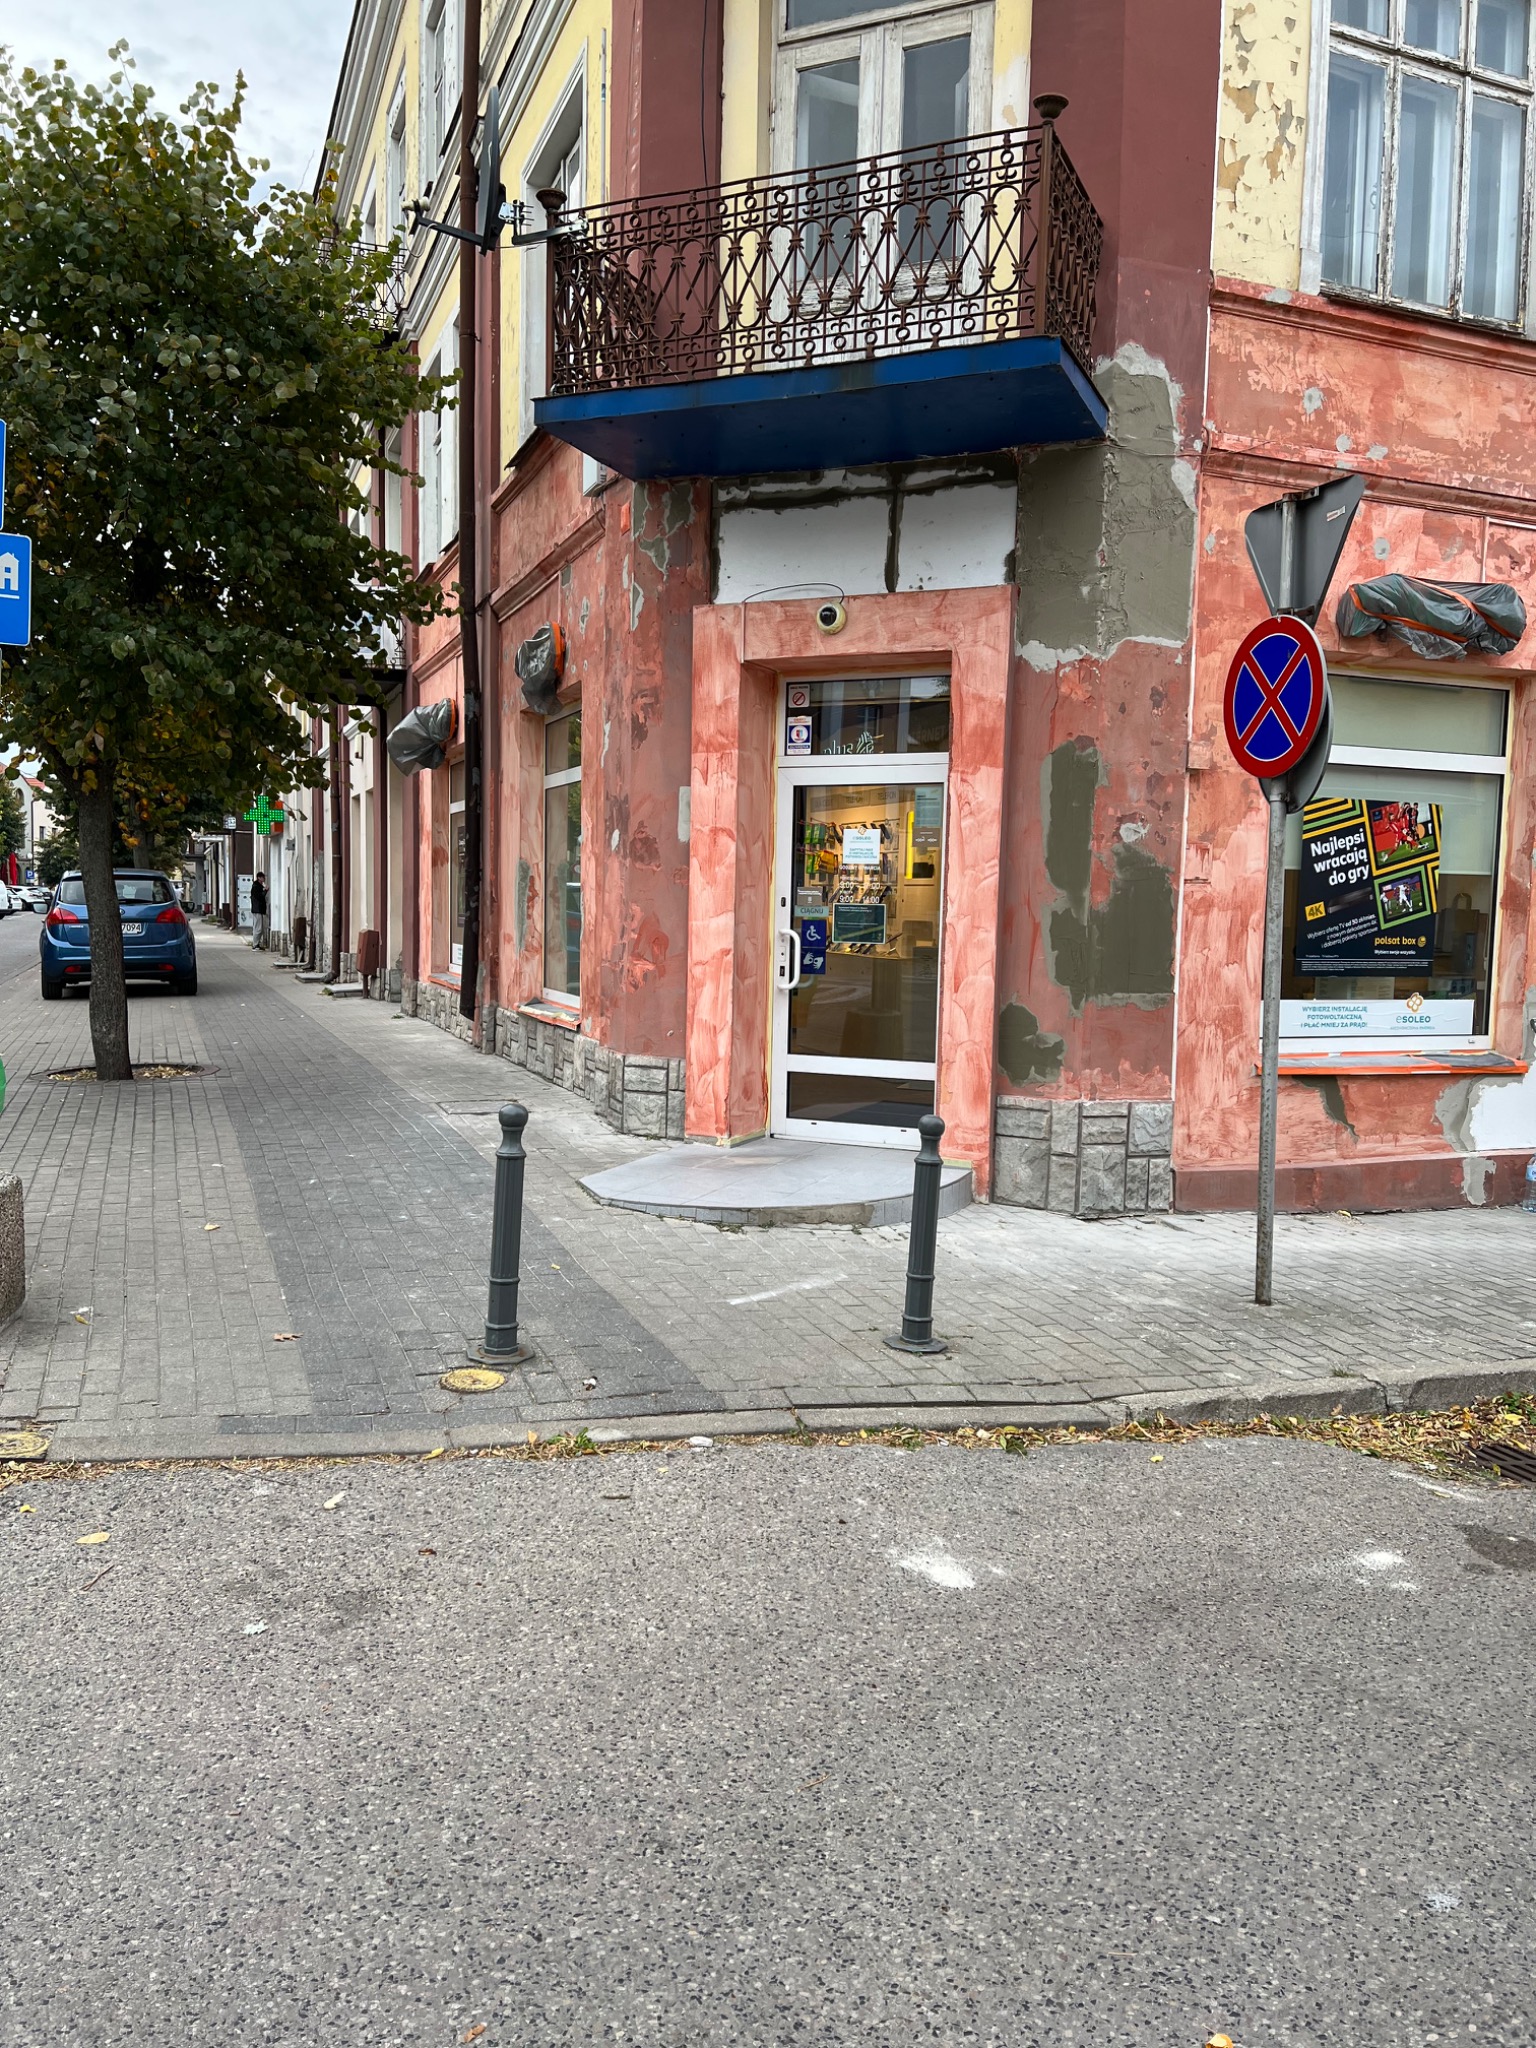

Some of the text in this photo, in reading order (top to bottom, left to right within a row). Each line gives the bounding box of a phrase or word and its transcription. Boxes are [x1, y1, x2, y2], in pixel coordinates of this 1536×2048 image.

[1310, 828, 1365, 857] Najlepsi
[1313, 847, 1368, 873] wracają
[1329, 864, 1370, 886] do gry
[1307, 904, 1323, 918] 4K
[1374, 936, 1417, 946] polsat box
